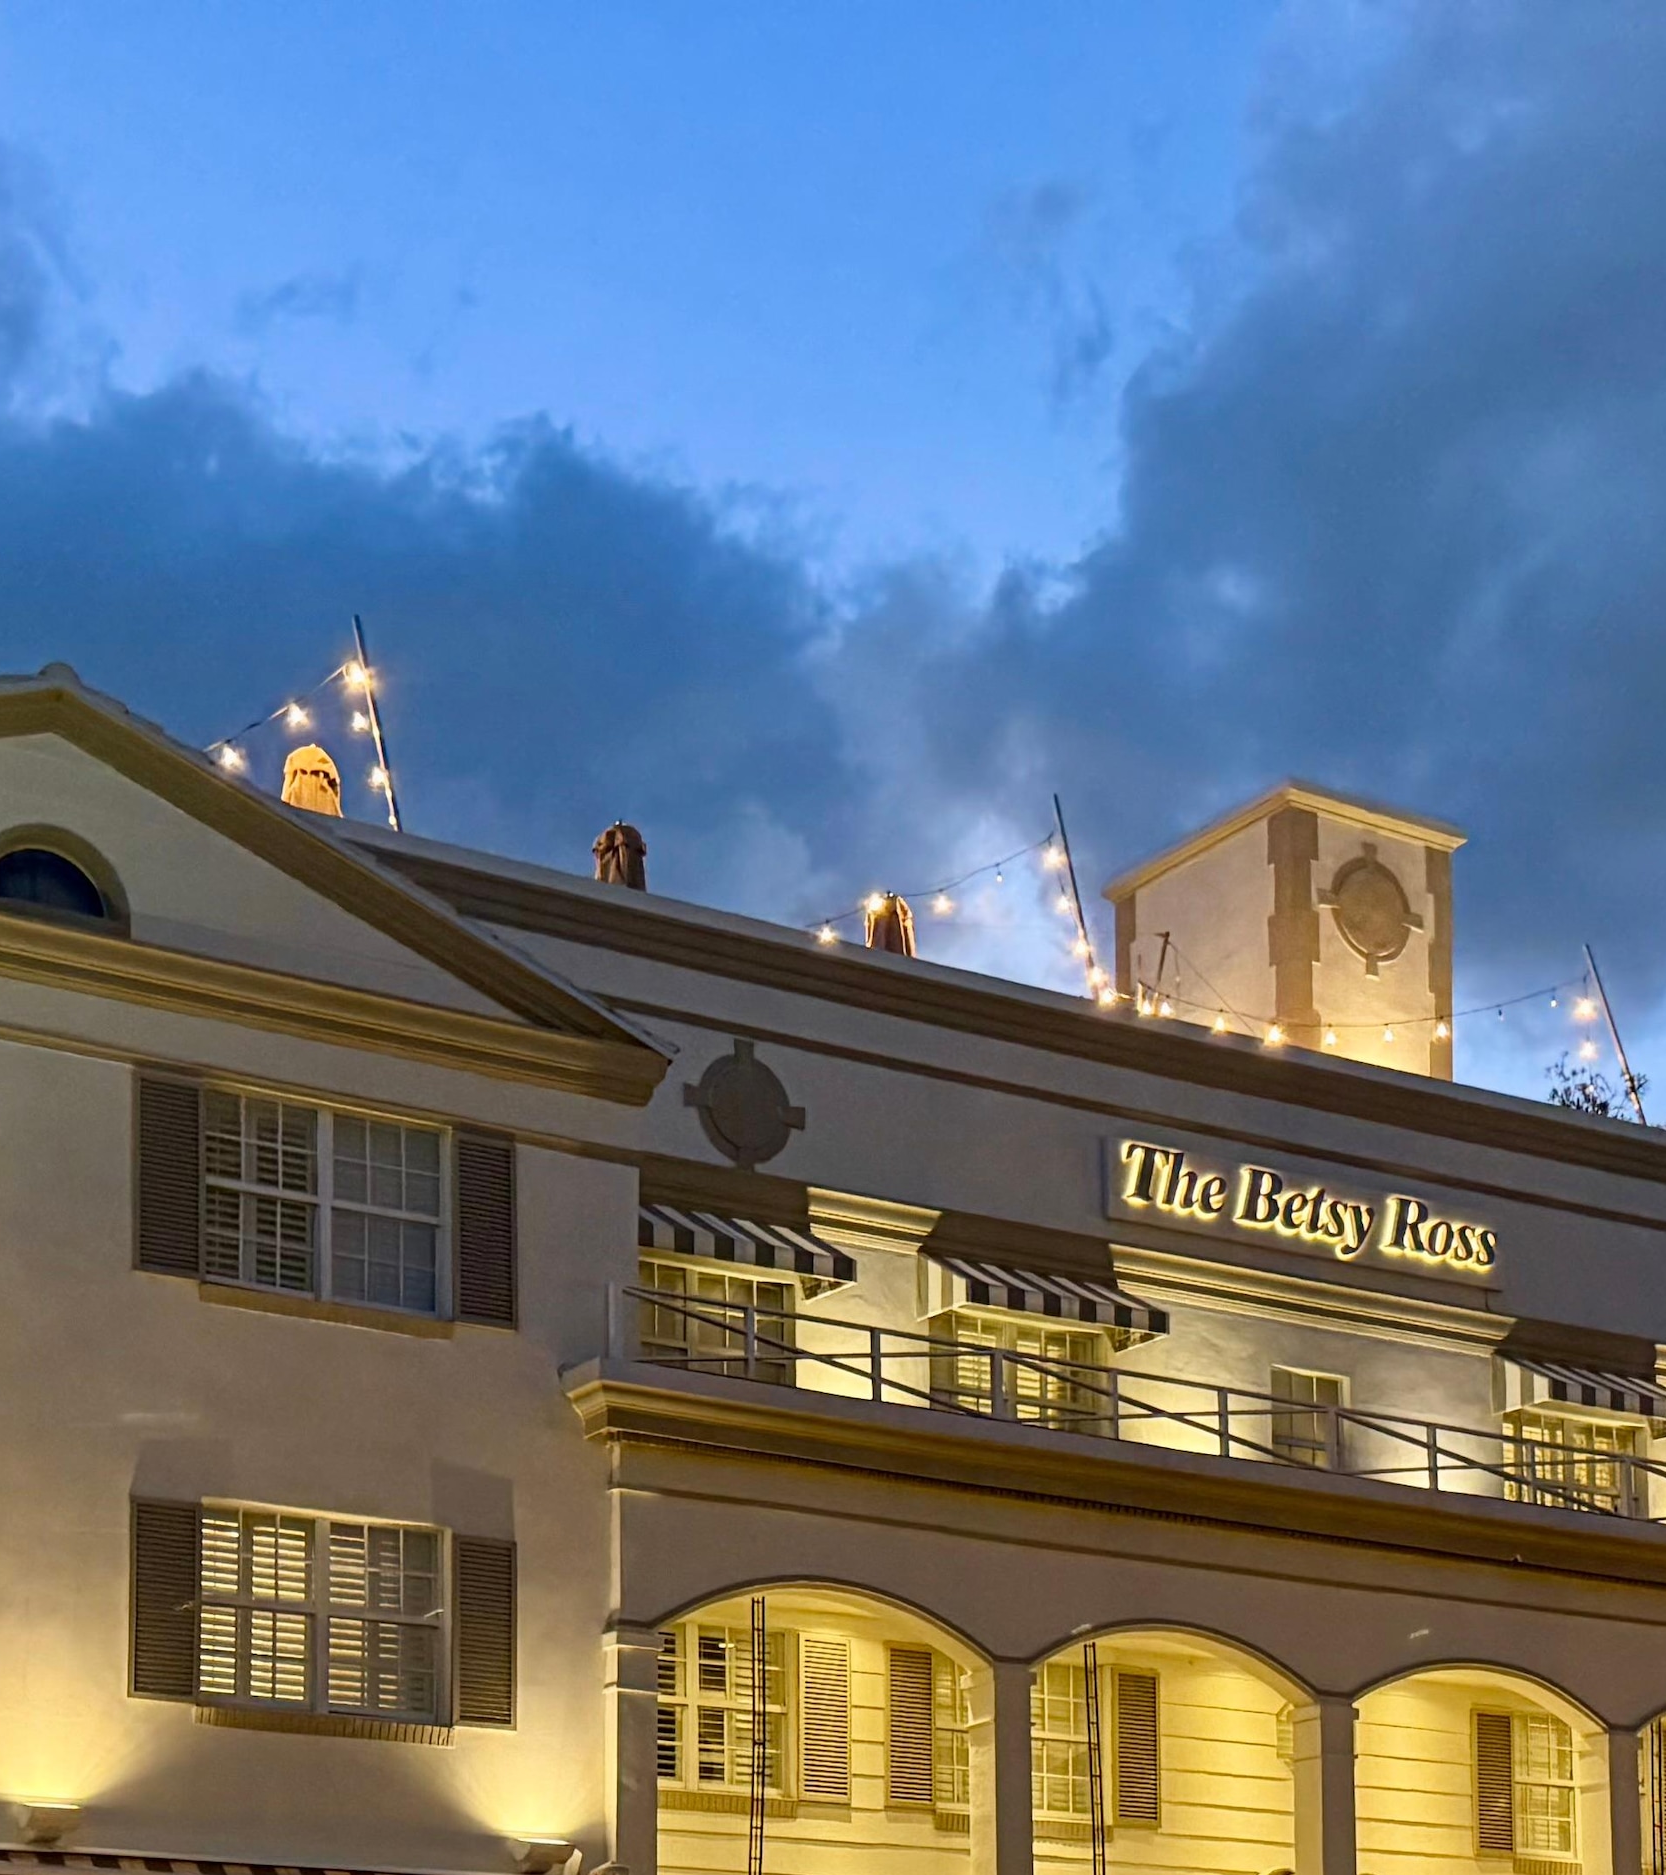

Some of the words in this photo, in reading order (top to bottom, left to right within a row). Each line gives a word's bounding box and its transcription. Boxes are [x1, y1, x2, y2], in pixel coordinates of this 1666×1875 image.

[1123, 1141, 1226, 1217] The
[1235, 1165, 1375, 1258] Betsy
[1380, 1195, 1499, 1271] Ross
